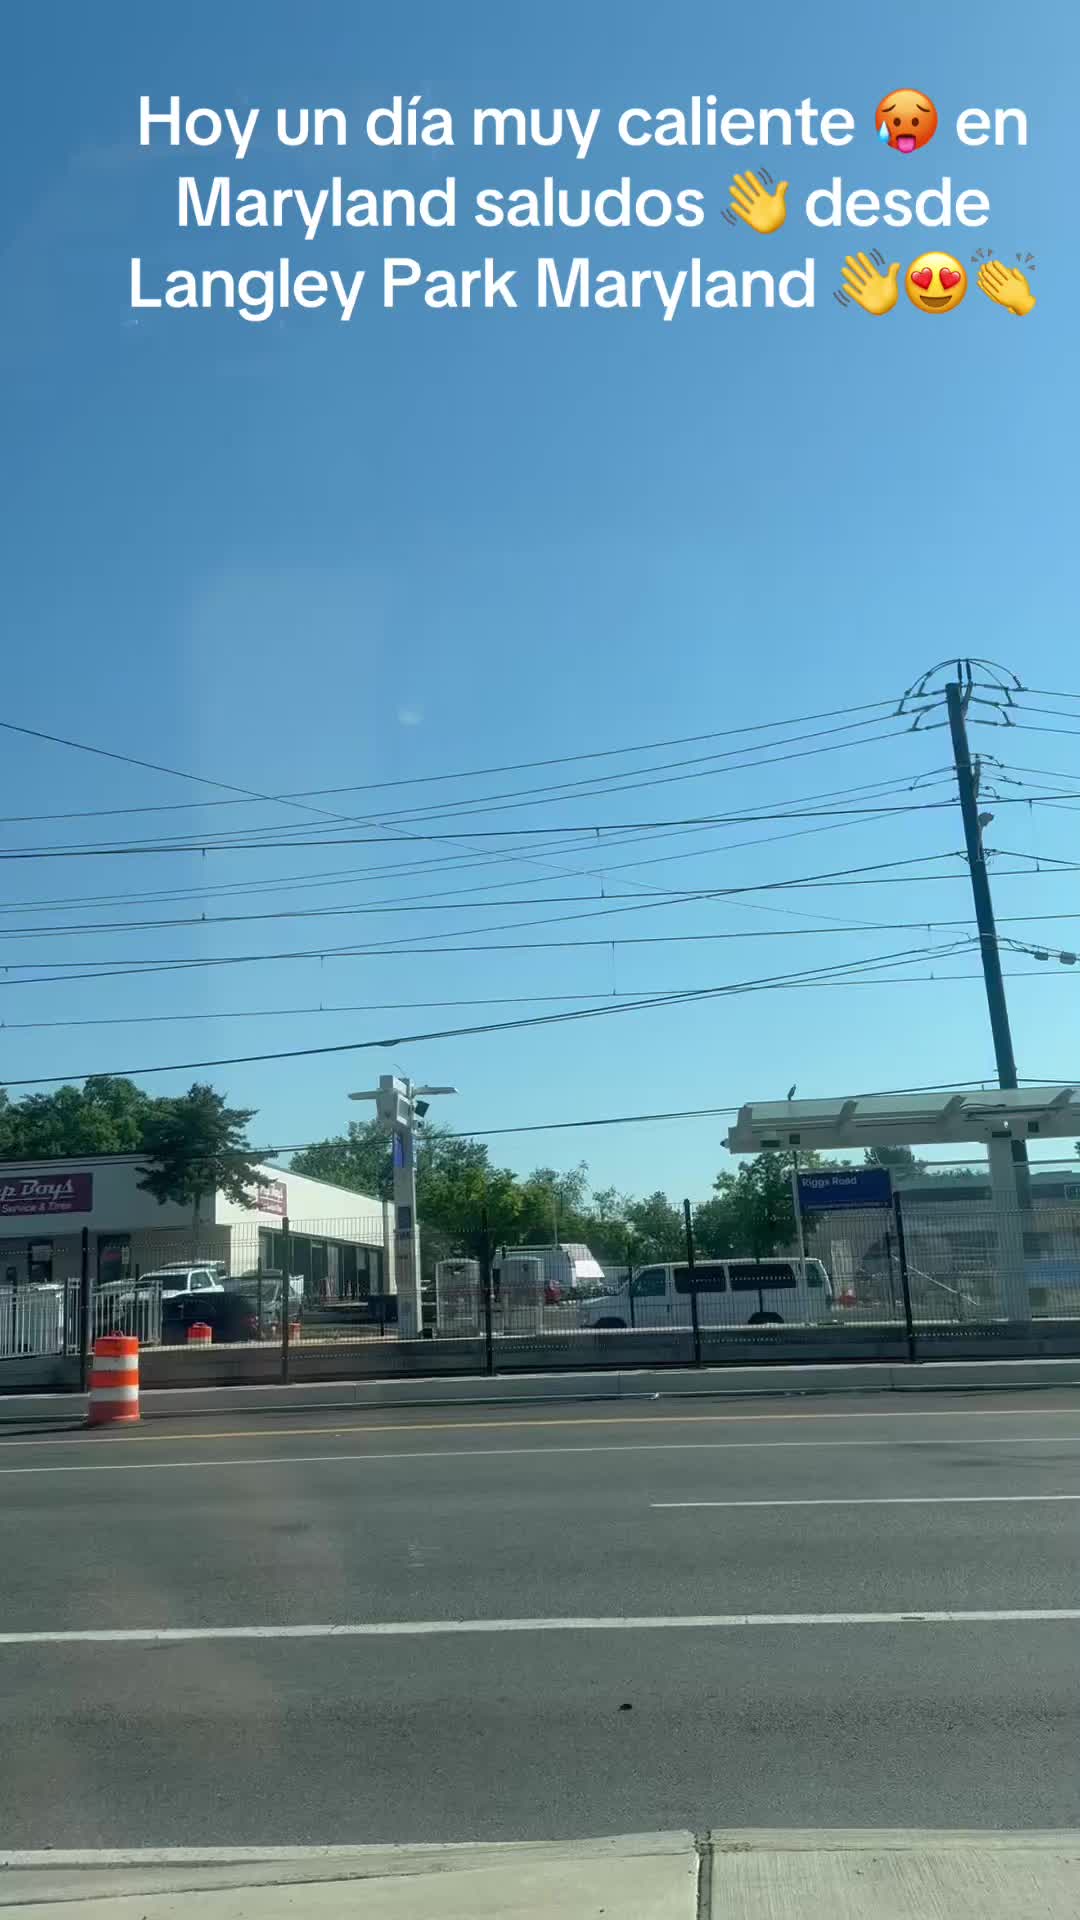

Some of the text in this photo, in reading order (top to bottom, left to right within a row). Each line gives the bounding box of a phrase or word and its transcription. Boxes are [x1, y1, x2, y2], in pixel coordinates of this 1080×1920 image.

[19, 1179, 74, 1200] Boys
[802, 1176, 857, 1188] Riggs Road
